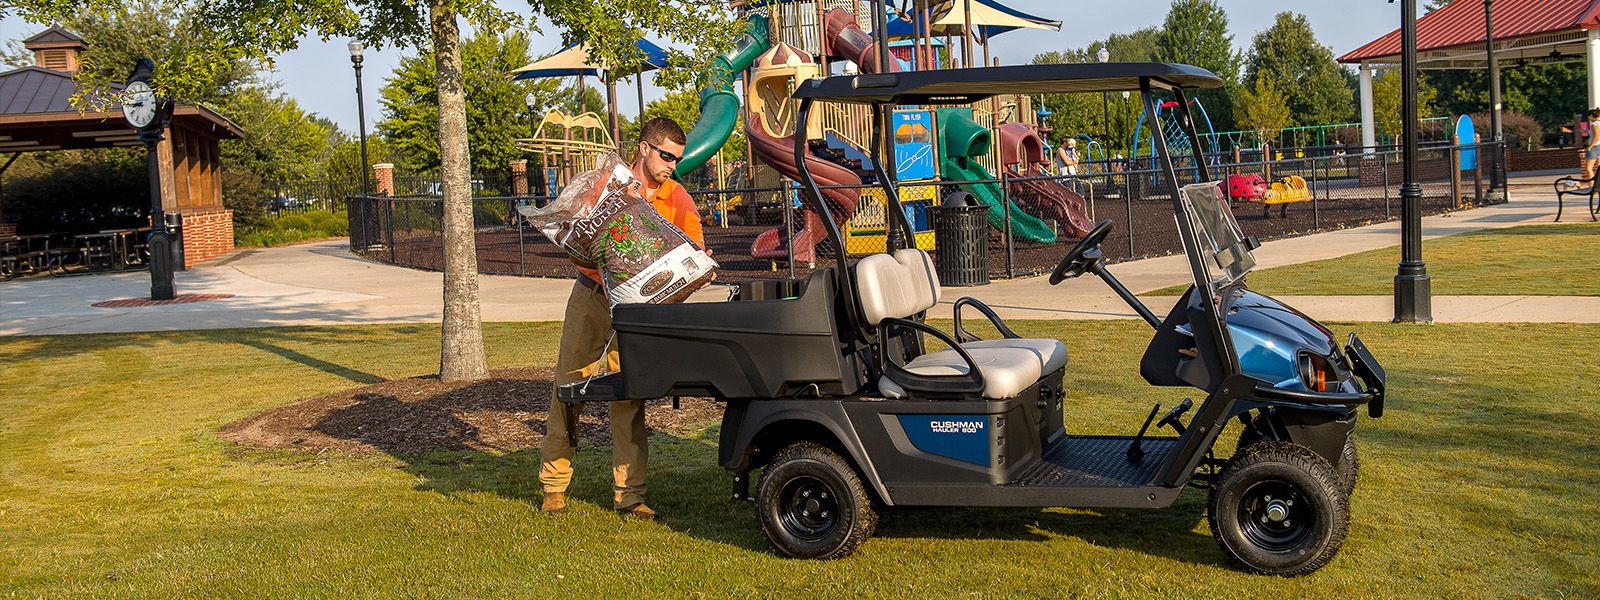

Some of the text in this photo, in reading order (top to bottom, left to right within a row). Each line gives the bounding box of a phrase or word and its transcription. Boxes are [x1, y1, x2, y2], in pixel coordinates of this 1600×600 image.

[584, 197, 627, 239] MULCH
[666, 279, 686, 294] MULCH
[930, 421, 984, 429] CUSHMAN
